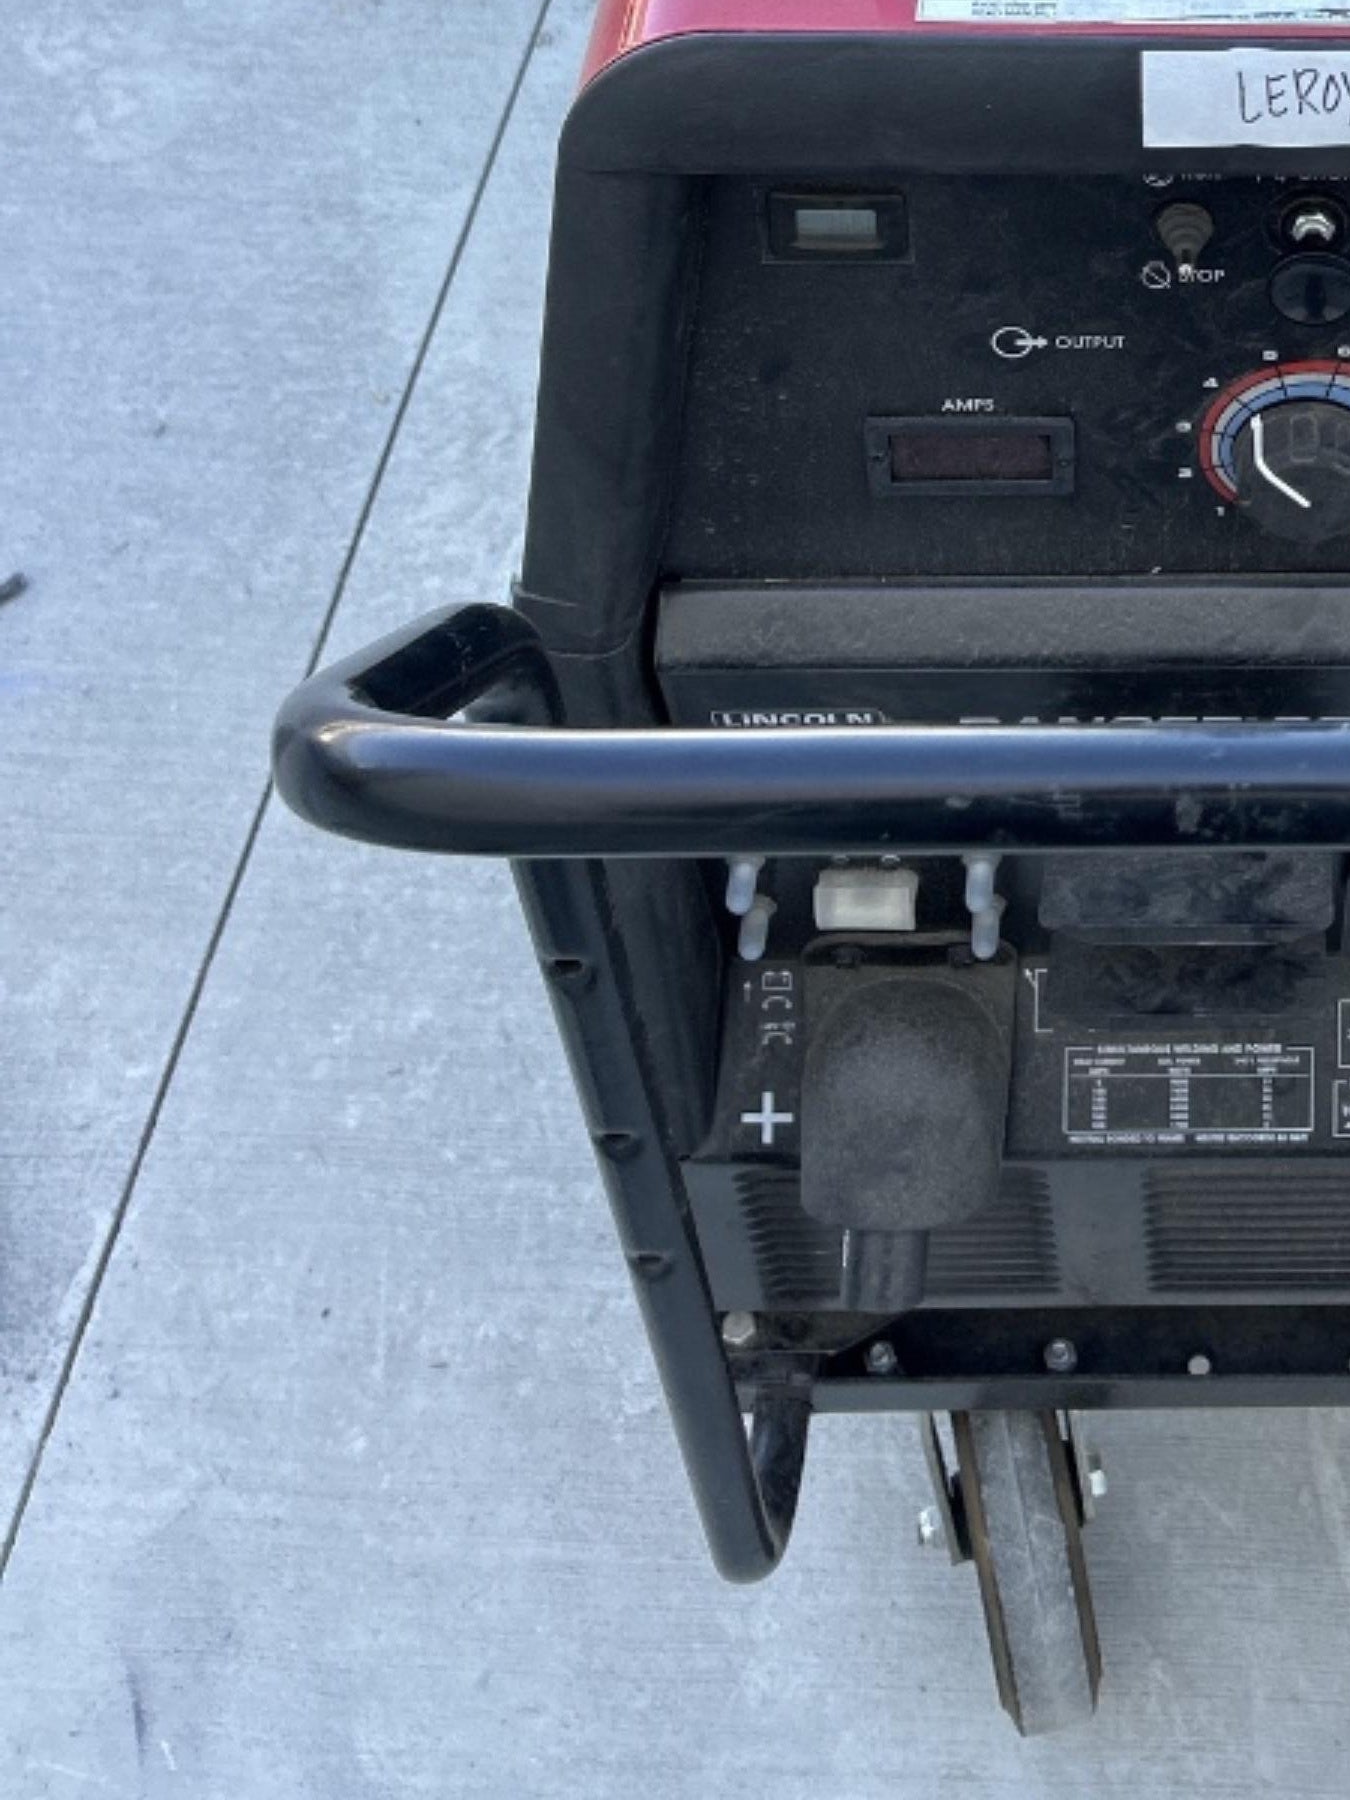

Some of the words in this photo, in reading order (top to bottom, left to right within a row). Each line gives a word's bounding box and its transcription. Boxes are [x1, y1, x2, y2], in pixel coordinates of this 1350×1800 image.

[1054, 335, 1126, 350] OUTPUT
[1202, 376, 1219, 389] 4
[941, 398, 996, 413] AMPS
